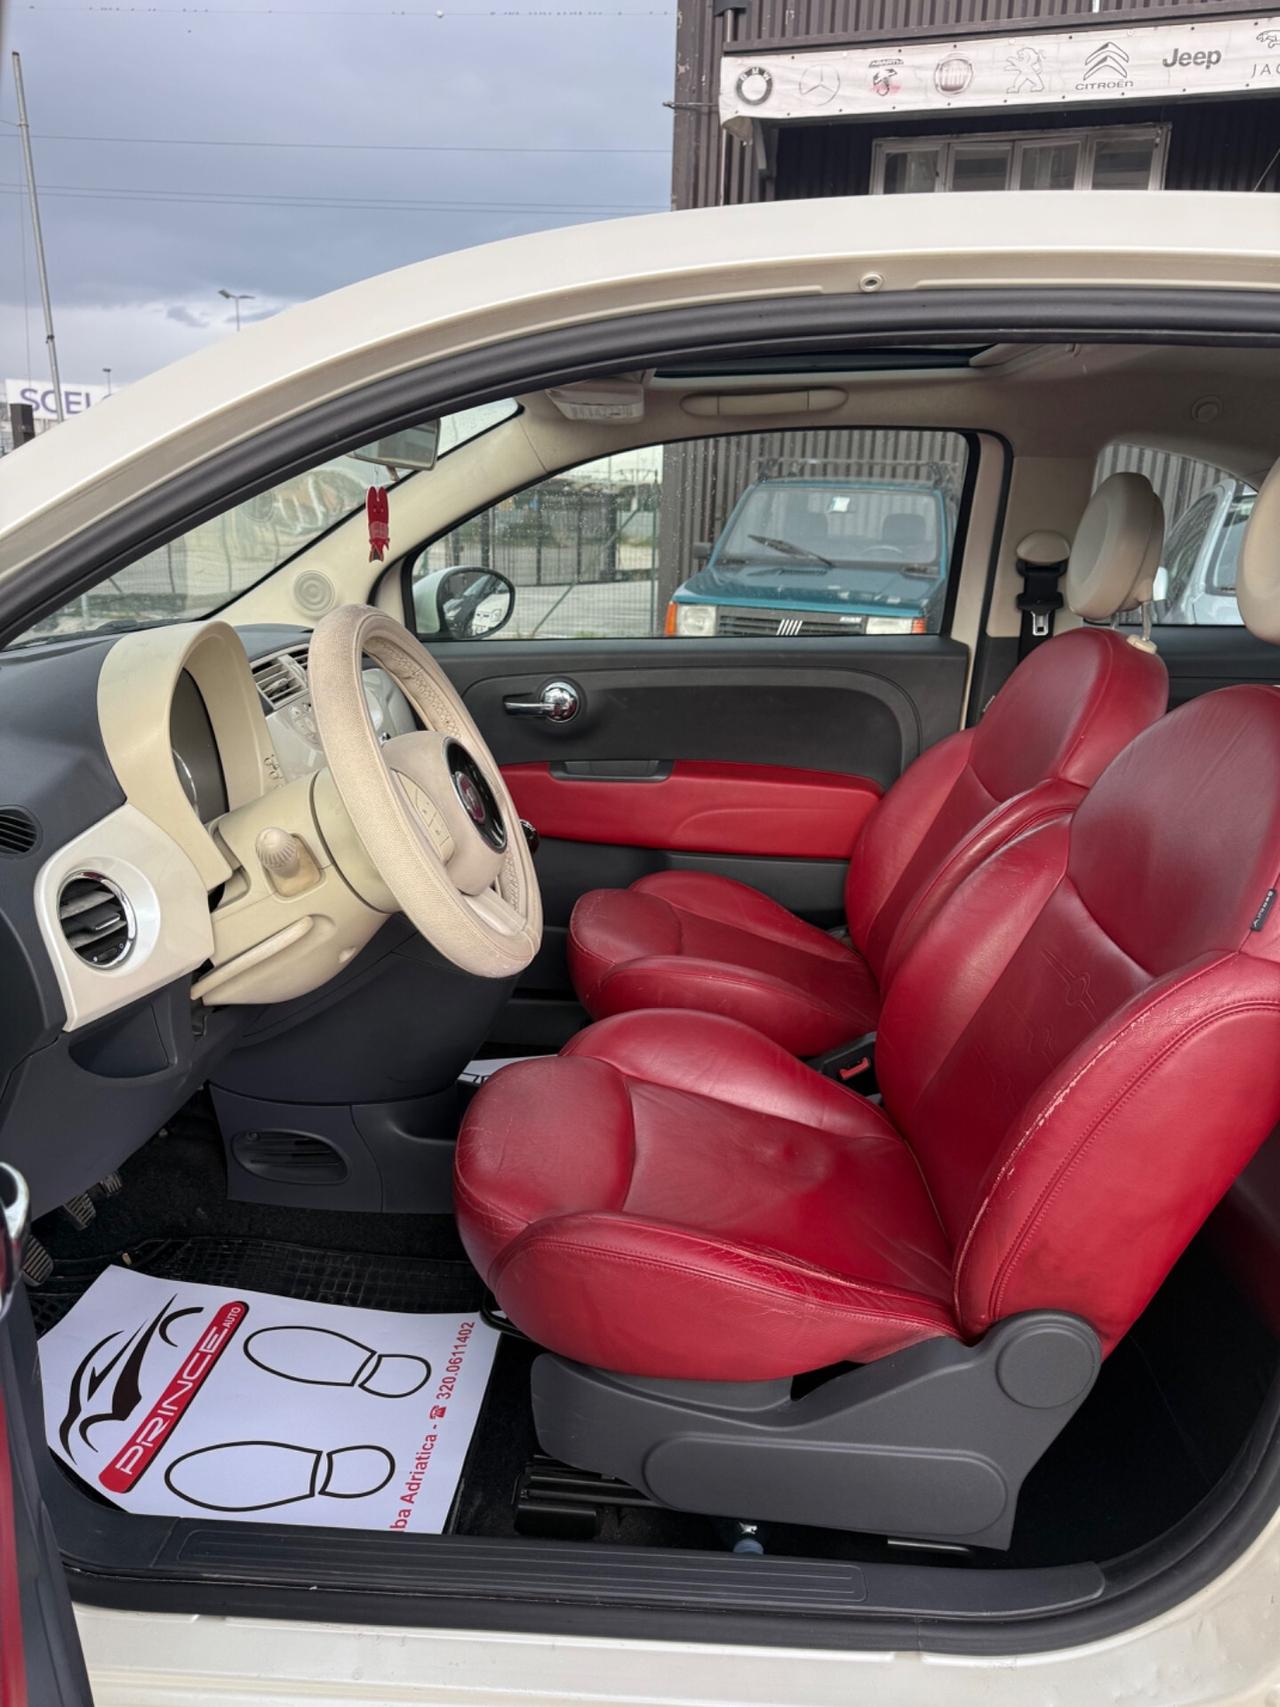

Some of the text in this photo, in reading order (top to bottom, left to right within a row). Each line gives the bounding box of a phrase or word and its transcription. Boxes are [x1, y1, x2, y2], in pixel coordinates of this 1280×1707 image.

[1162, 48, 1222, 70] Jeep
[222, 1307, 241, 1329] AUTO
[115, 1326, 228, 1475] PRINCE
[400, 1434, 438, 1504] Adriatica
[436, 1321, 475, 1400] 320.0611402
